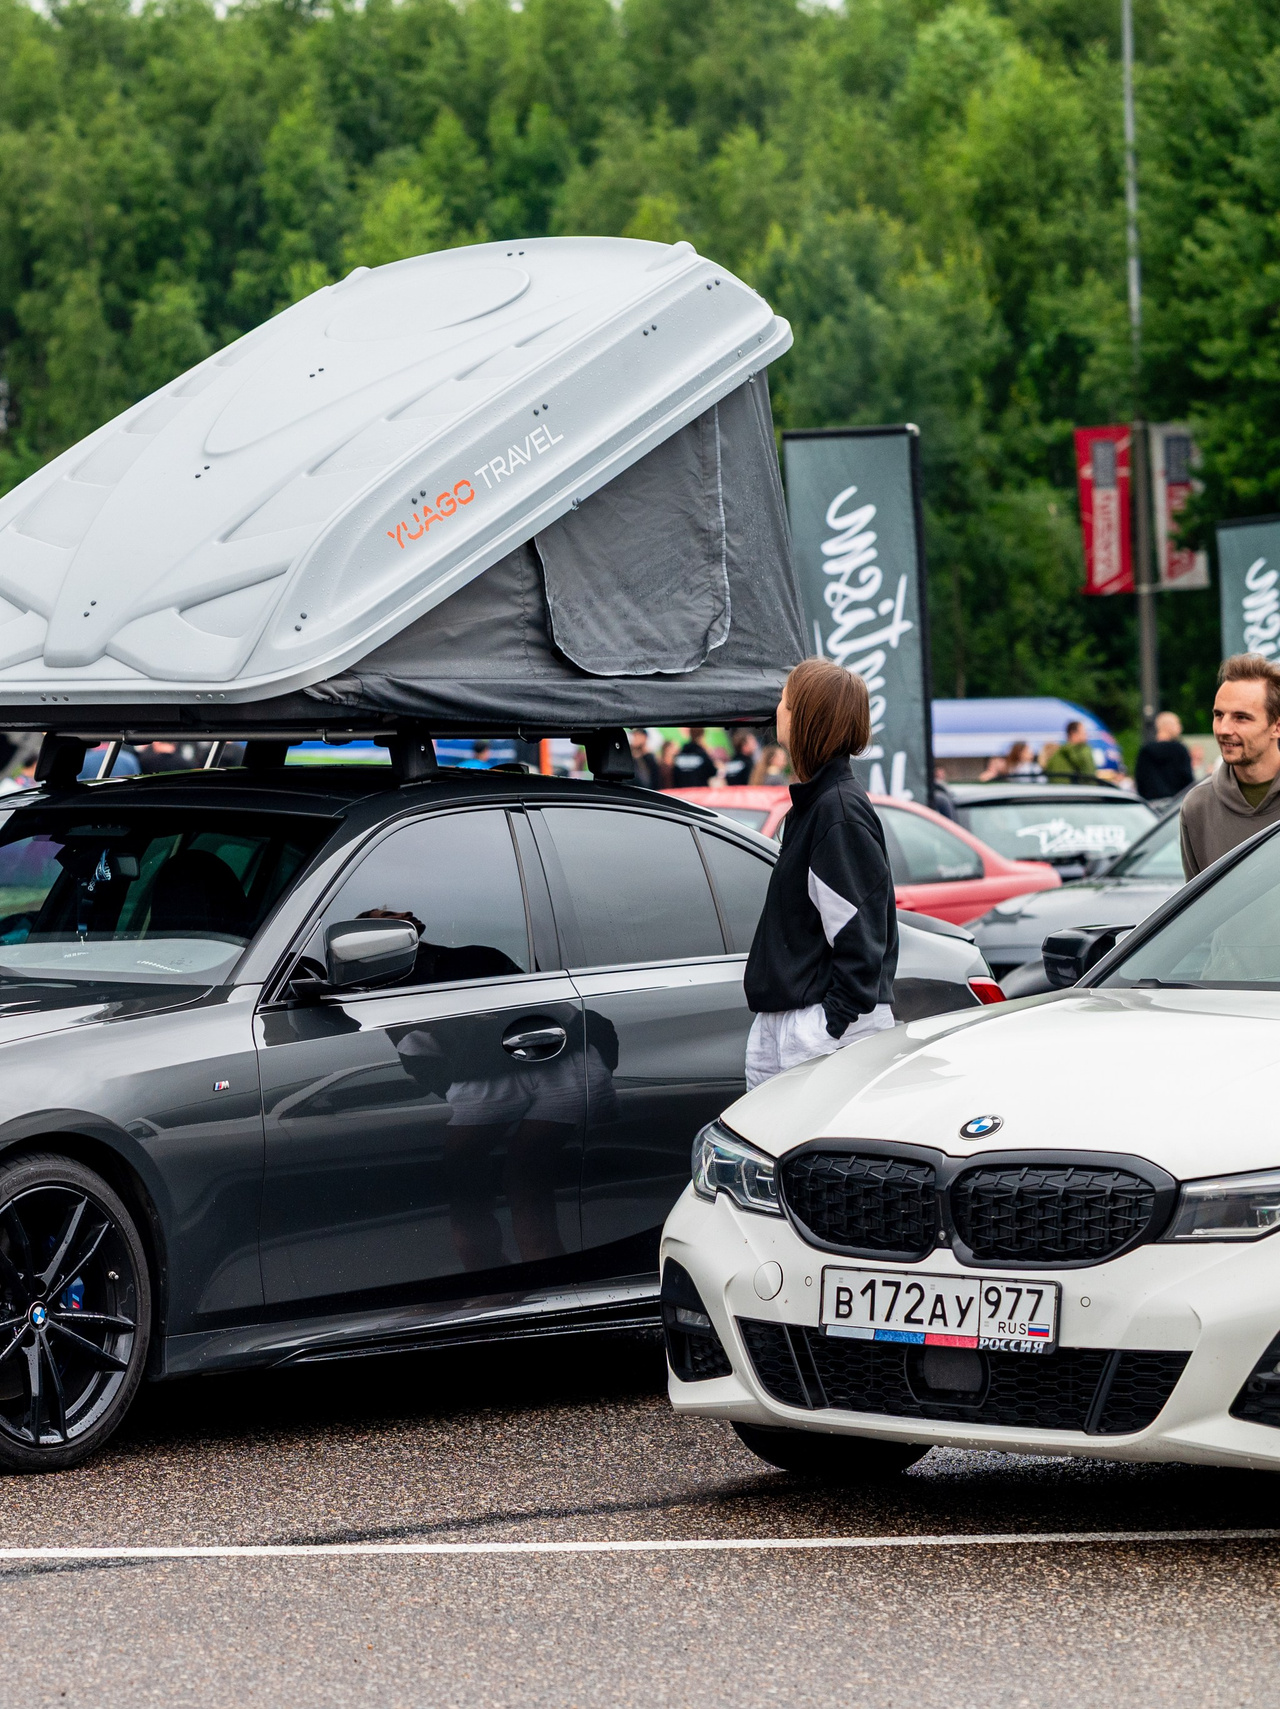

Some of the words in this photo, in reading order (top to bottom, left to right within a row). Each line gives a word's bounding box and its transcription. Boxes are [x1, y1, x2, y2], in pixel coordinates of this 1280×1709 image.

[387, 479, 475, 549] YUAGO
[474, 424, 564, 489] TRAVEL
[984, 1286, 1044, 1321] 977
[998, 1321, 1026, 1335] RUS
[978, 1337, 1045, 1353] РОССИЯ
